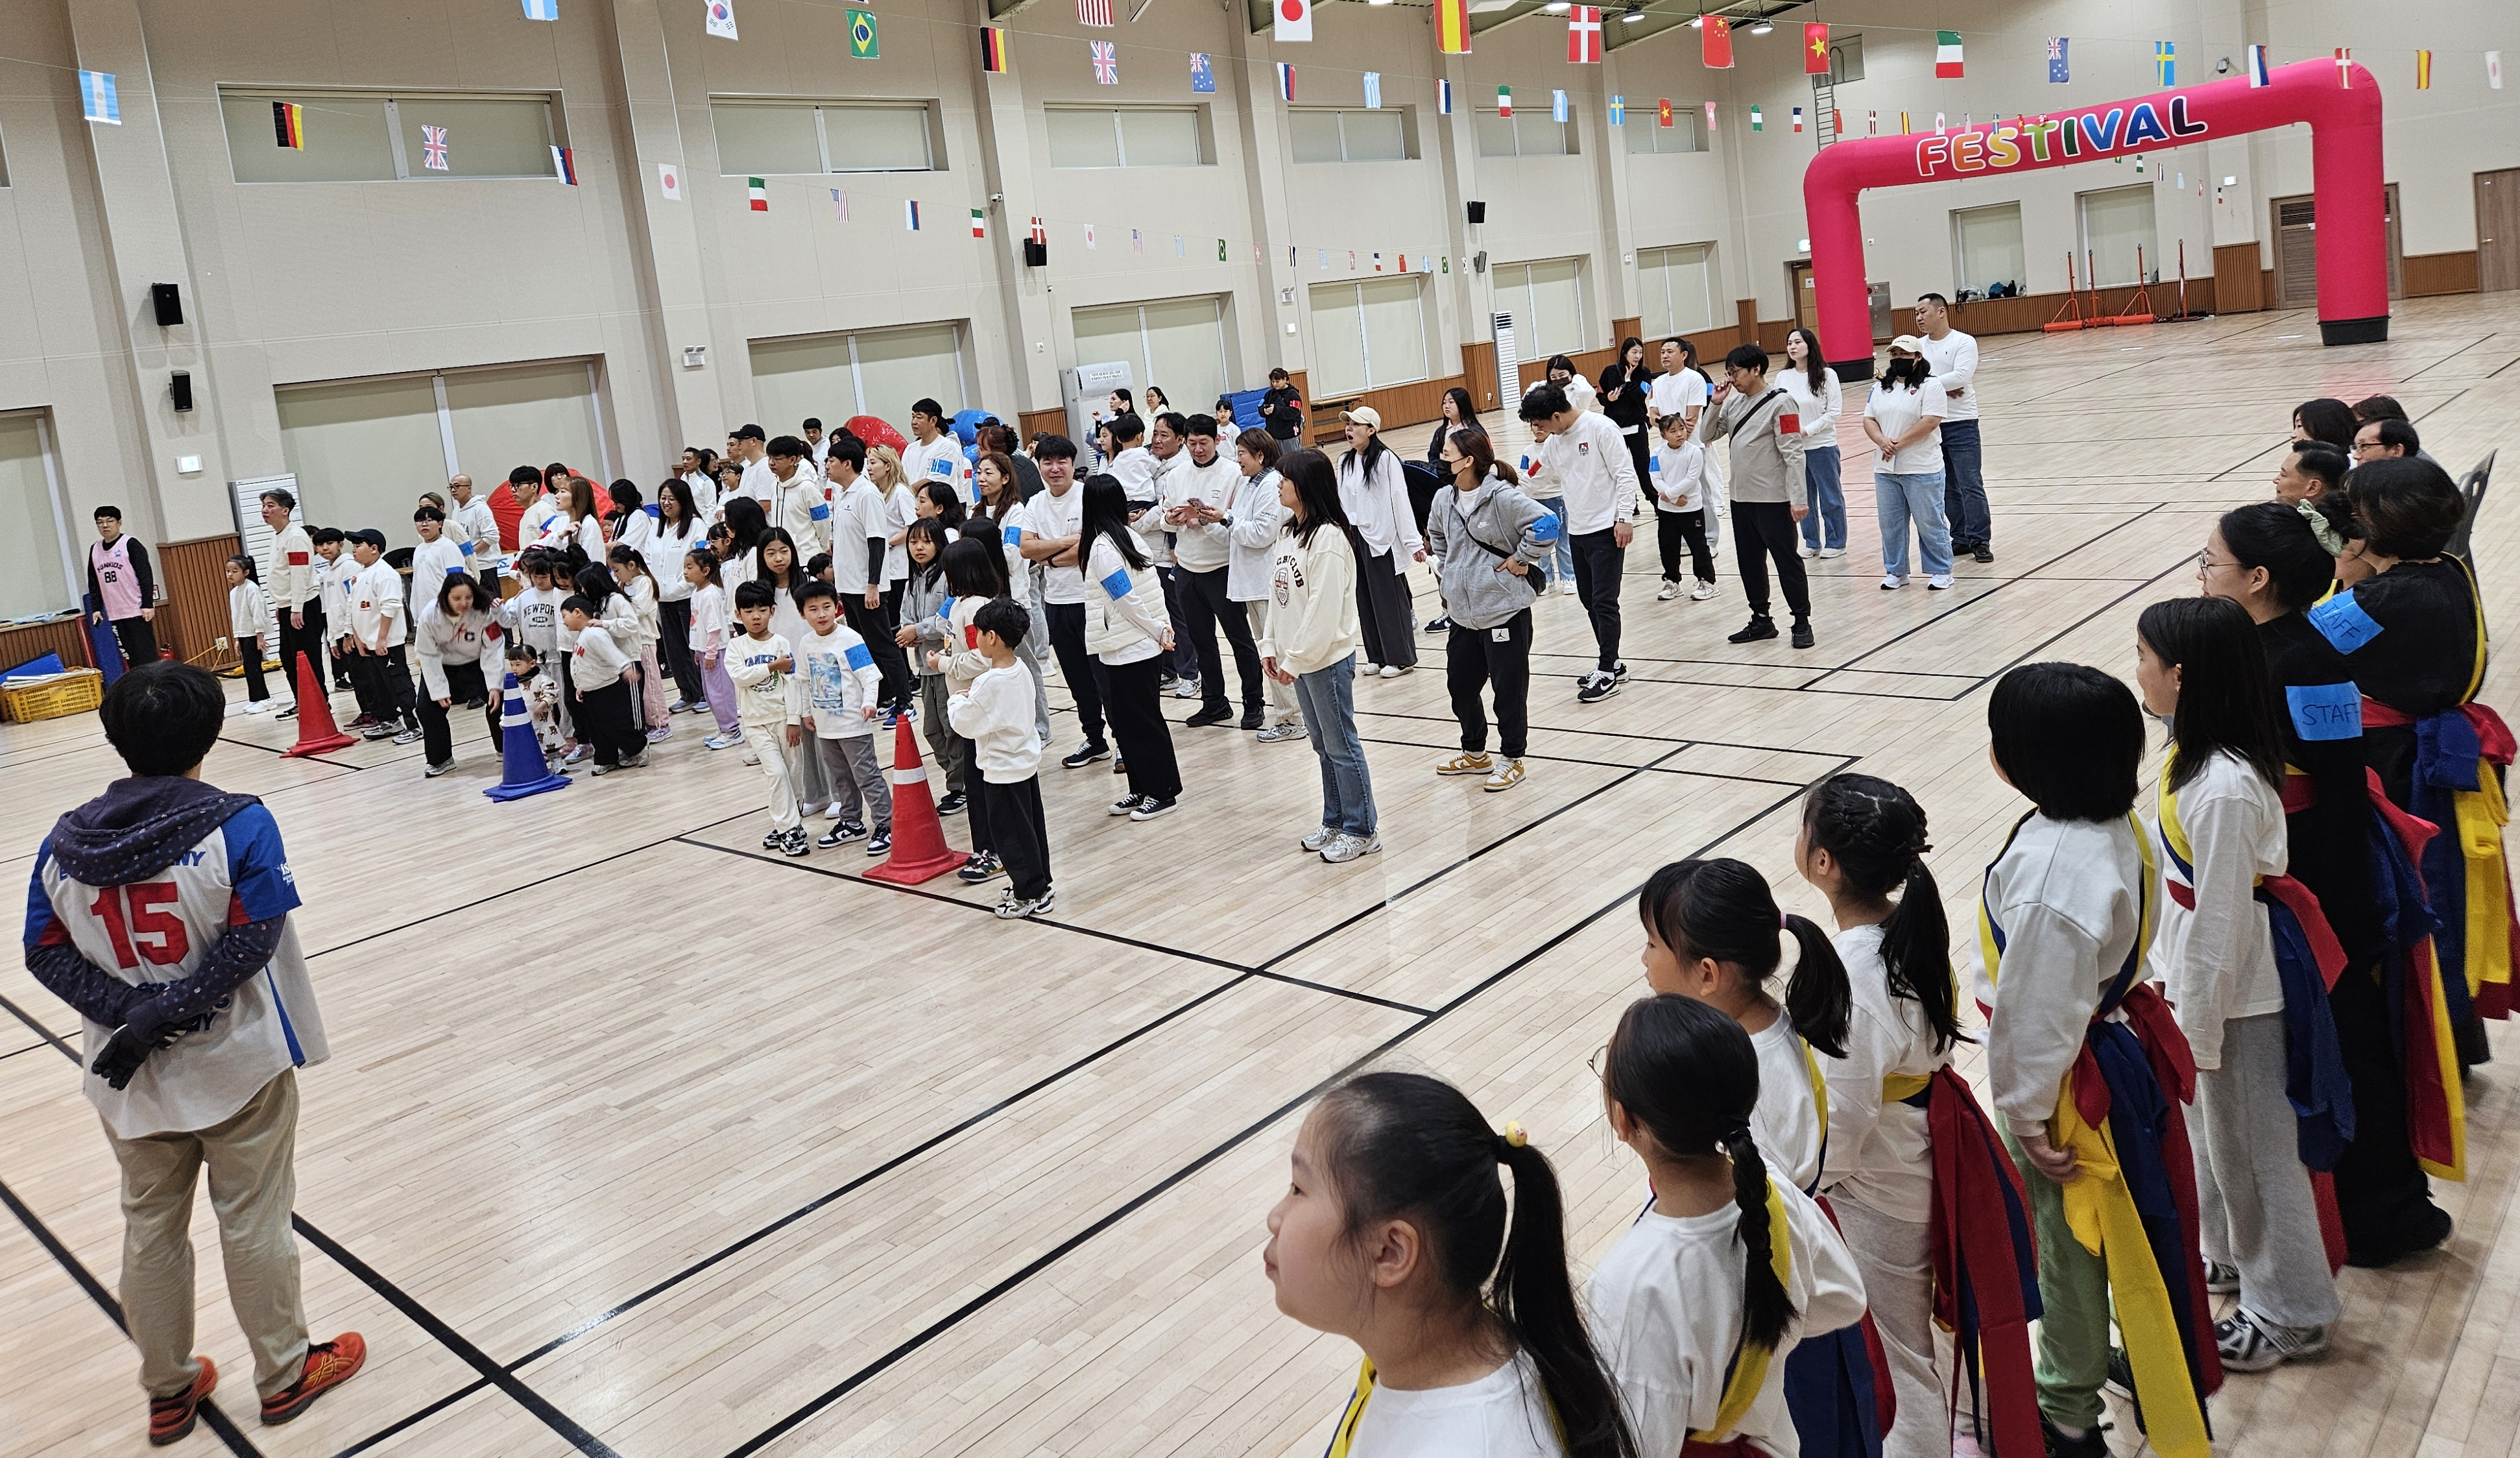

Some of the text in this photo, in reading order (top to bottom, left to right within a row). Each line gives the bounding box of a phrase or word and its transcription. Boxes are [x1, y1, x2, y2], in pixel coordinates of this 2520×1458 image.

[1917, 96, 2208, 176] FESTIVAL
[104, 571, 117, 583] 88
[1290, 557, 1304, 588] CLUB
[523, 603, 555, 618] NEWPOR
[745, 655, 777, 667] YANKE
[2302, 703, 2359, 725] STAF
[90, 882, 189, 969] 15
